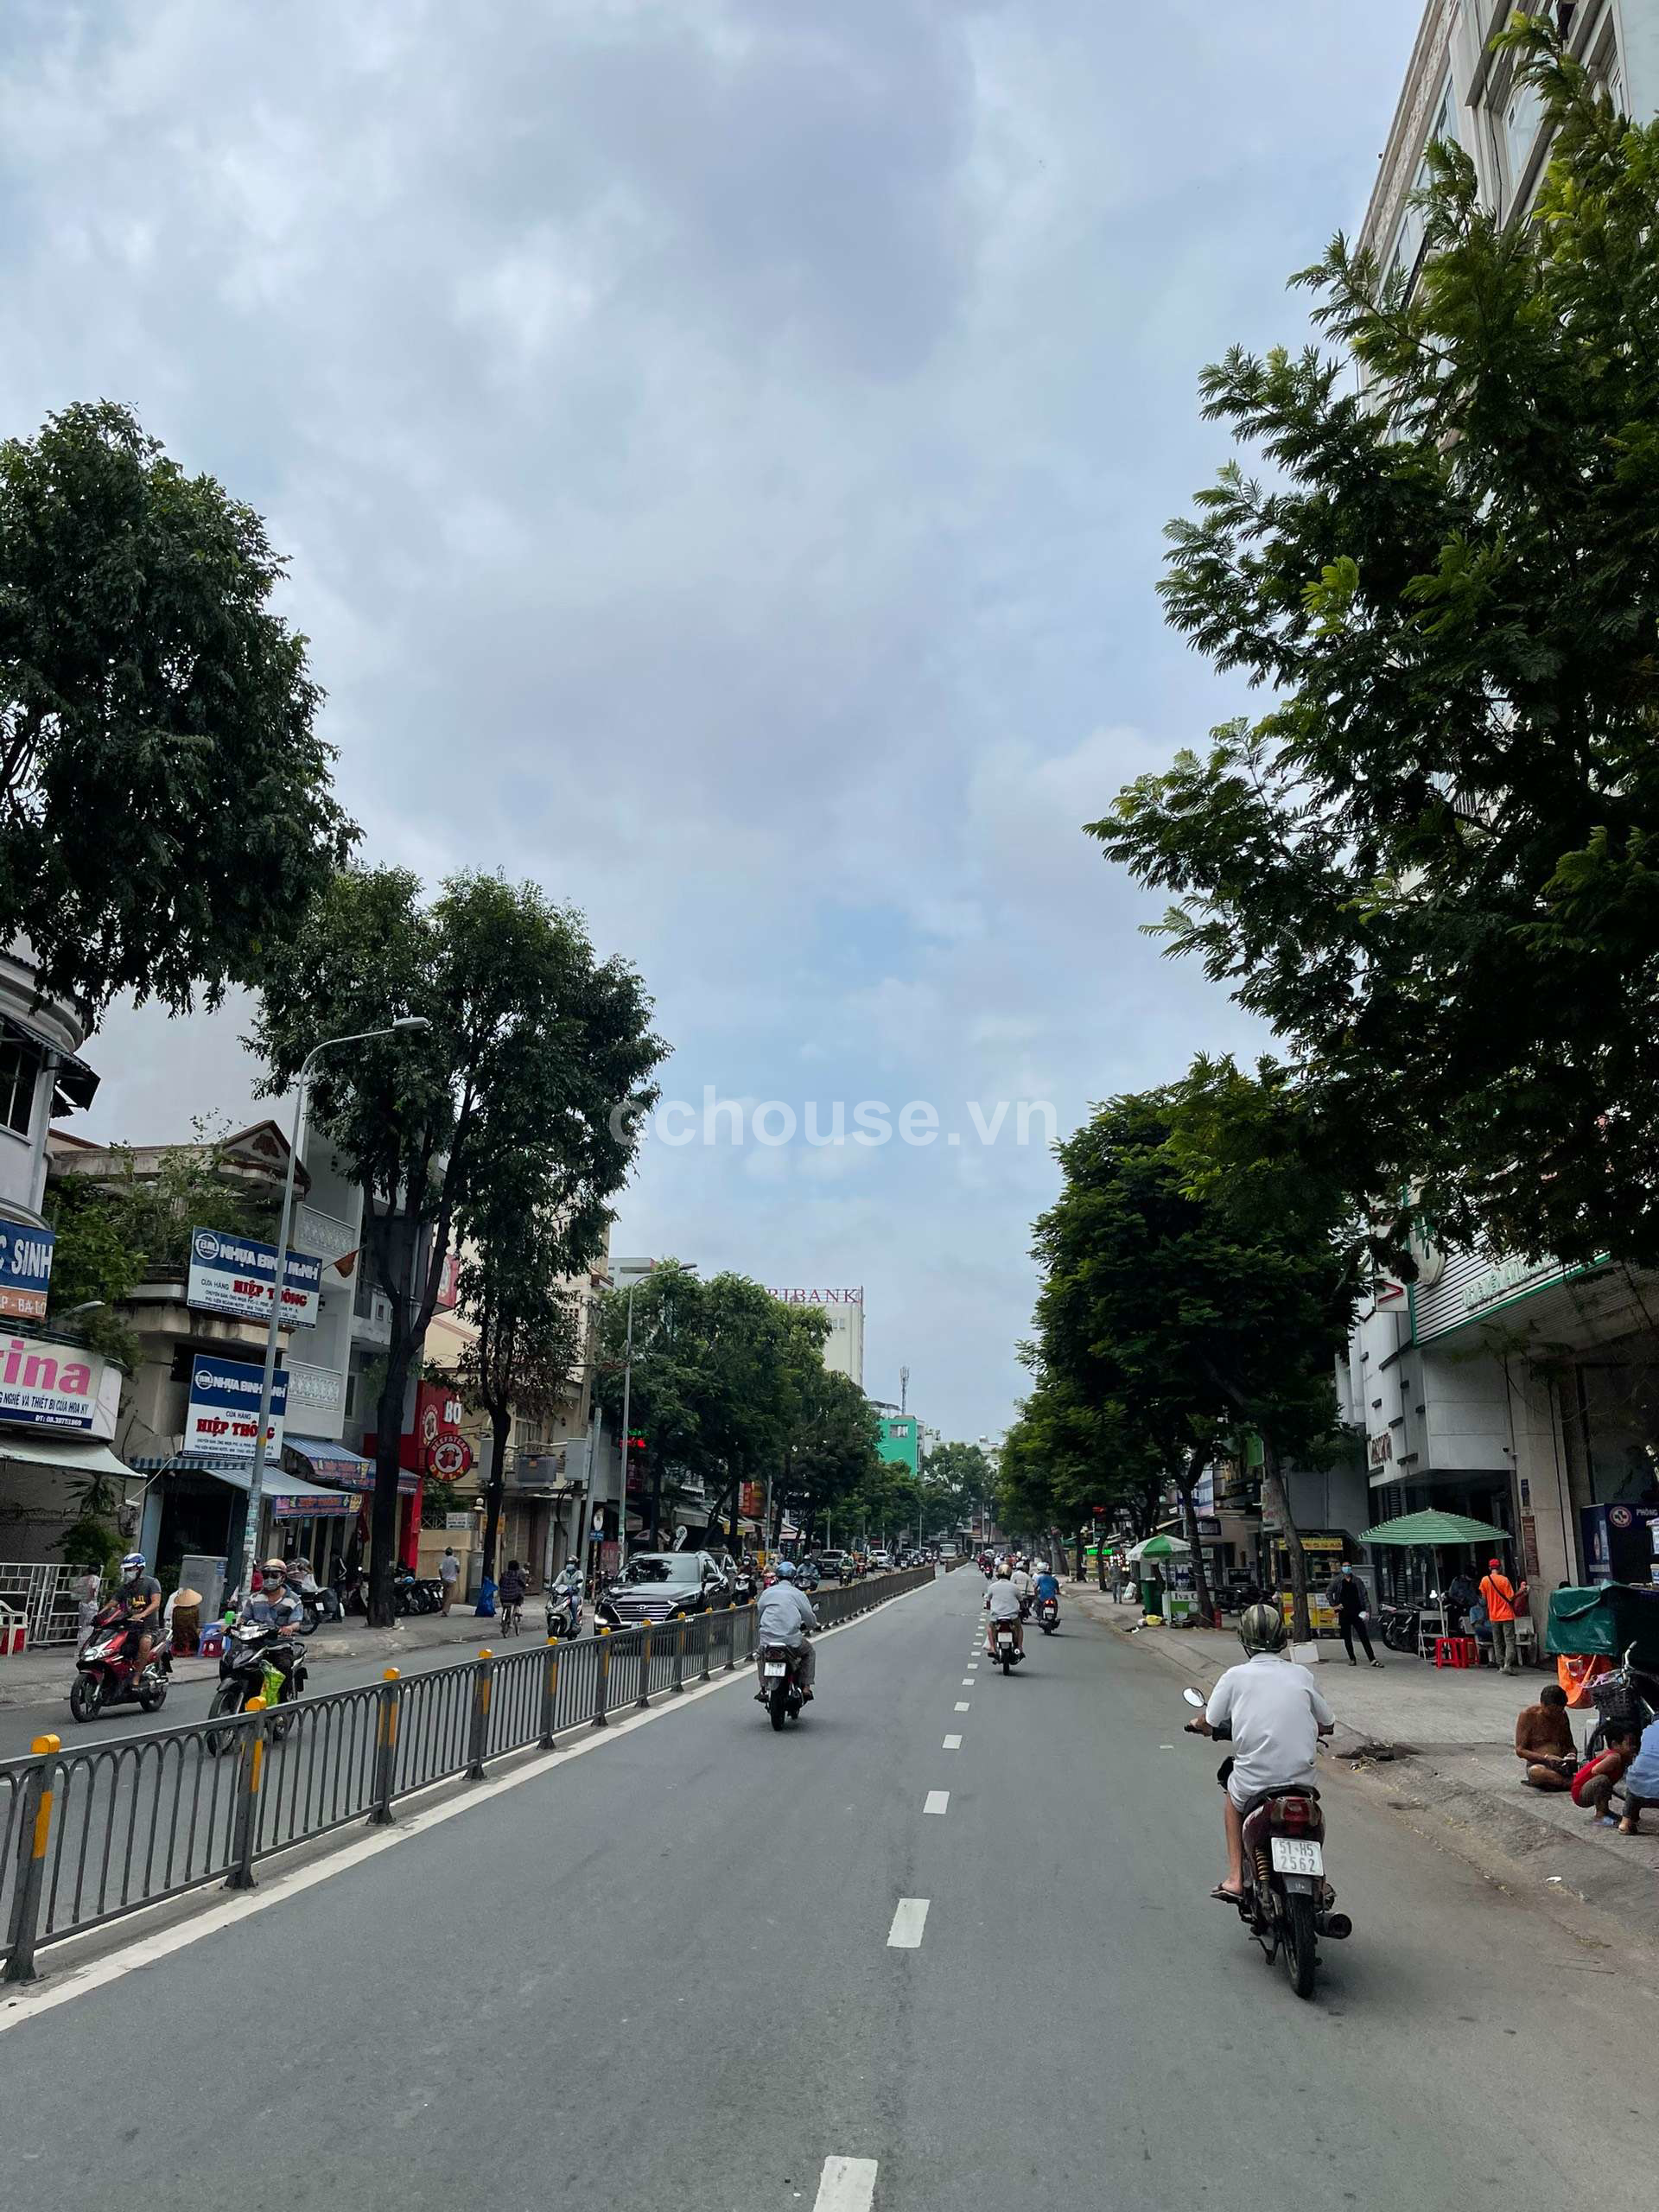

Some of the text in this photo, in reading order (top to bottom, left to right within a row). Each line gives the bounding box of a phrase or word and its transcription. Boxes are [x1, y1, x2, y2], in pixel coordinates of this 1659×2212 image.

[11, 1238, 54, 1280] SINH
[232, 1280, 264, 1299] HIỆP
[267, 1287, 308, 1306] TÔNG
[766, 1288, 859, 1303] RIBANK
[196, 1417, 275, 1440] HIỆP THÔG
[1281, 1856, 1315, 1872] 2562
